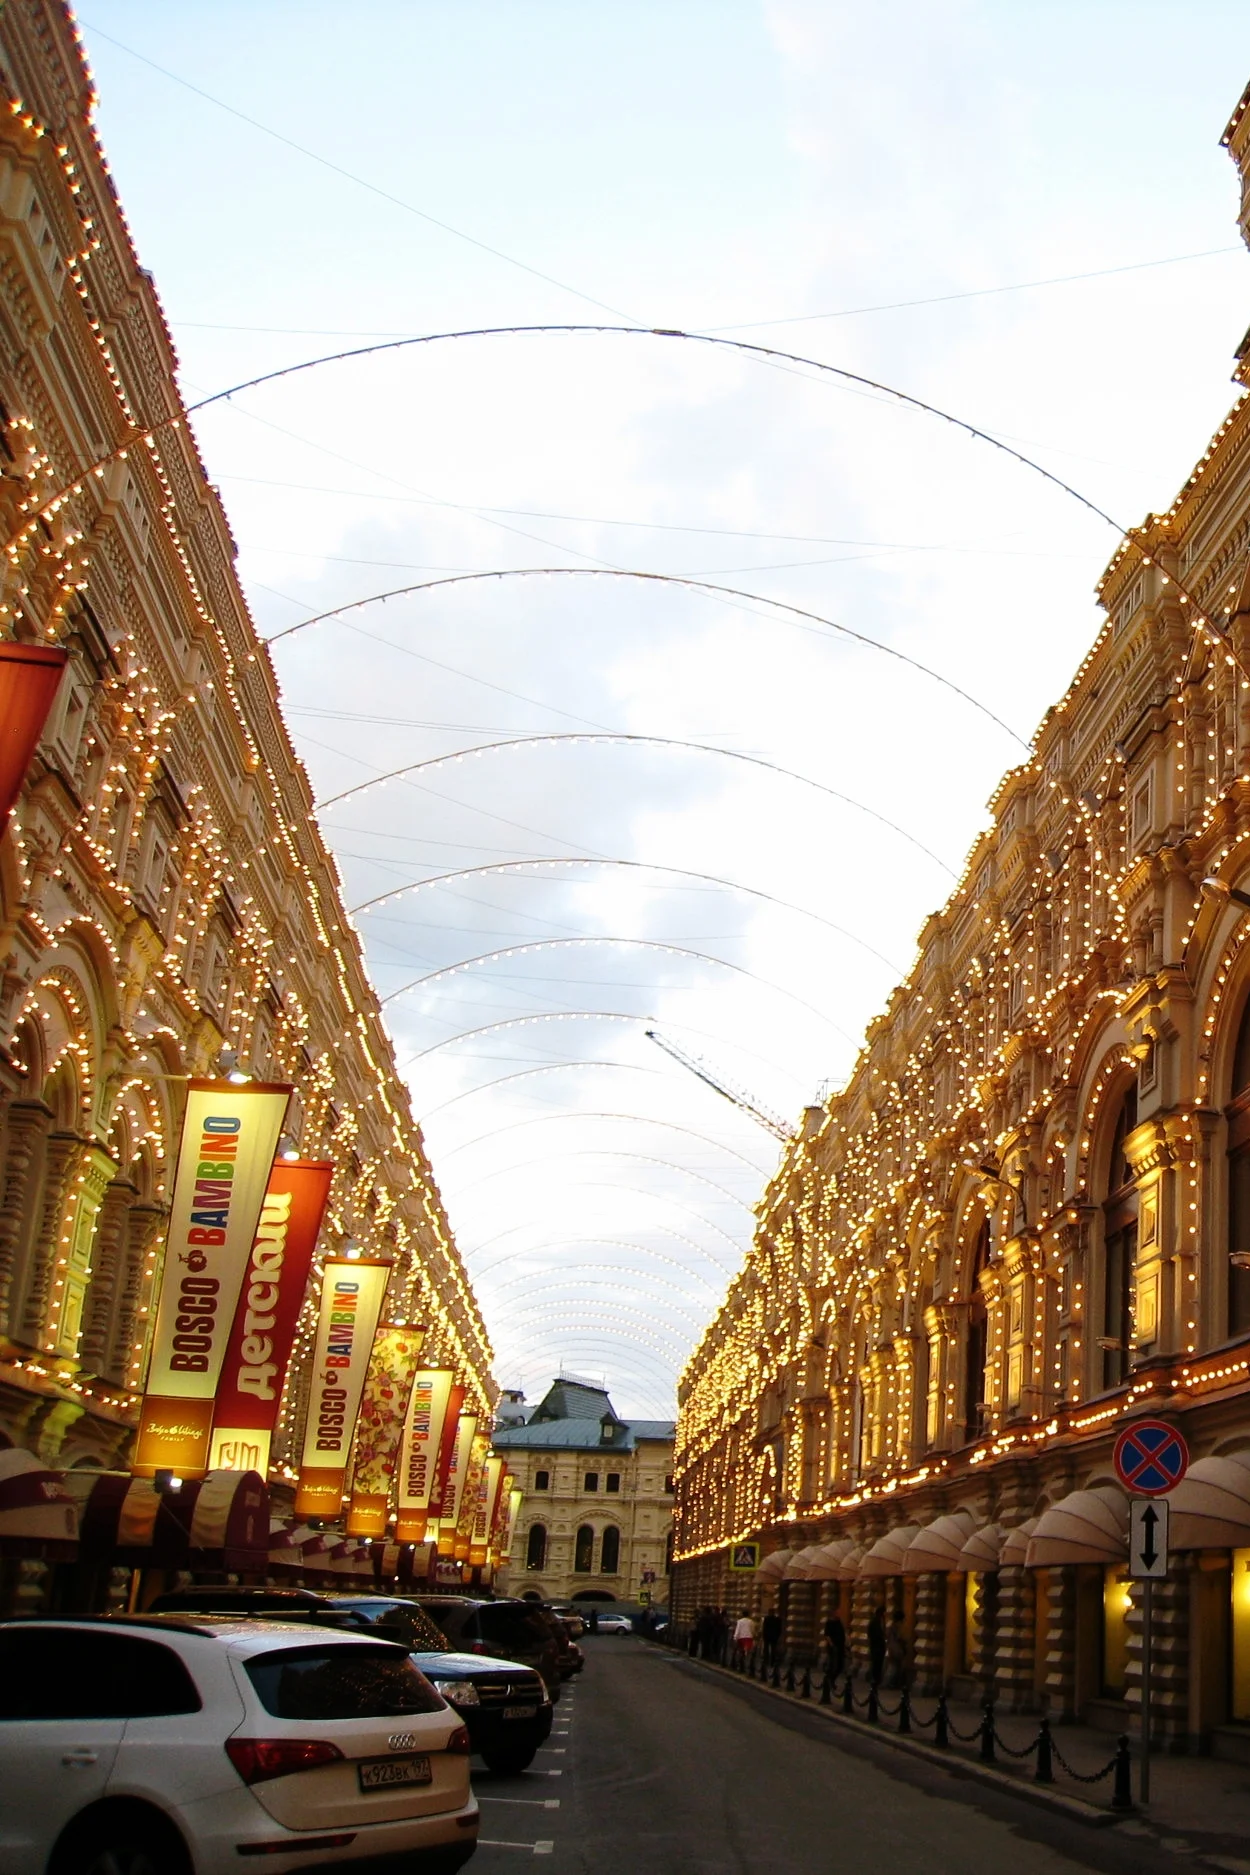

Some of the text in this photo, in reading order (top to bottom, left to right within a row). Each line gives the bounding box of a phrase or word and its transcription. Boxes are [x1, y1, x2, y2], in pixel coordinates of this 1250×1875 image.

[169, 1116, 241, 1373] BOSCO BAMBINO
[326, 1282, 359, 1368] BAMBINO
[316, 1388, 347, 1451] BOSCO
[412, 1382, 433, 1440] BAMBINO
[408, 1455, 427, 1497] BOSCO
